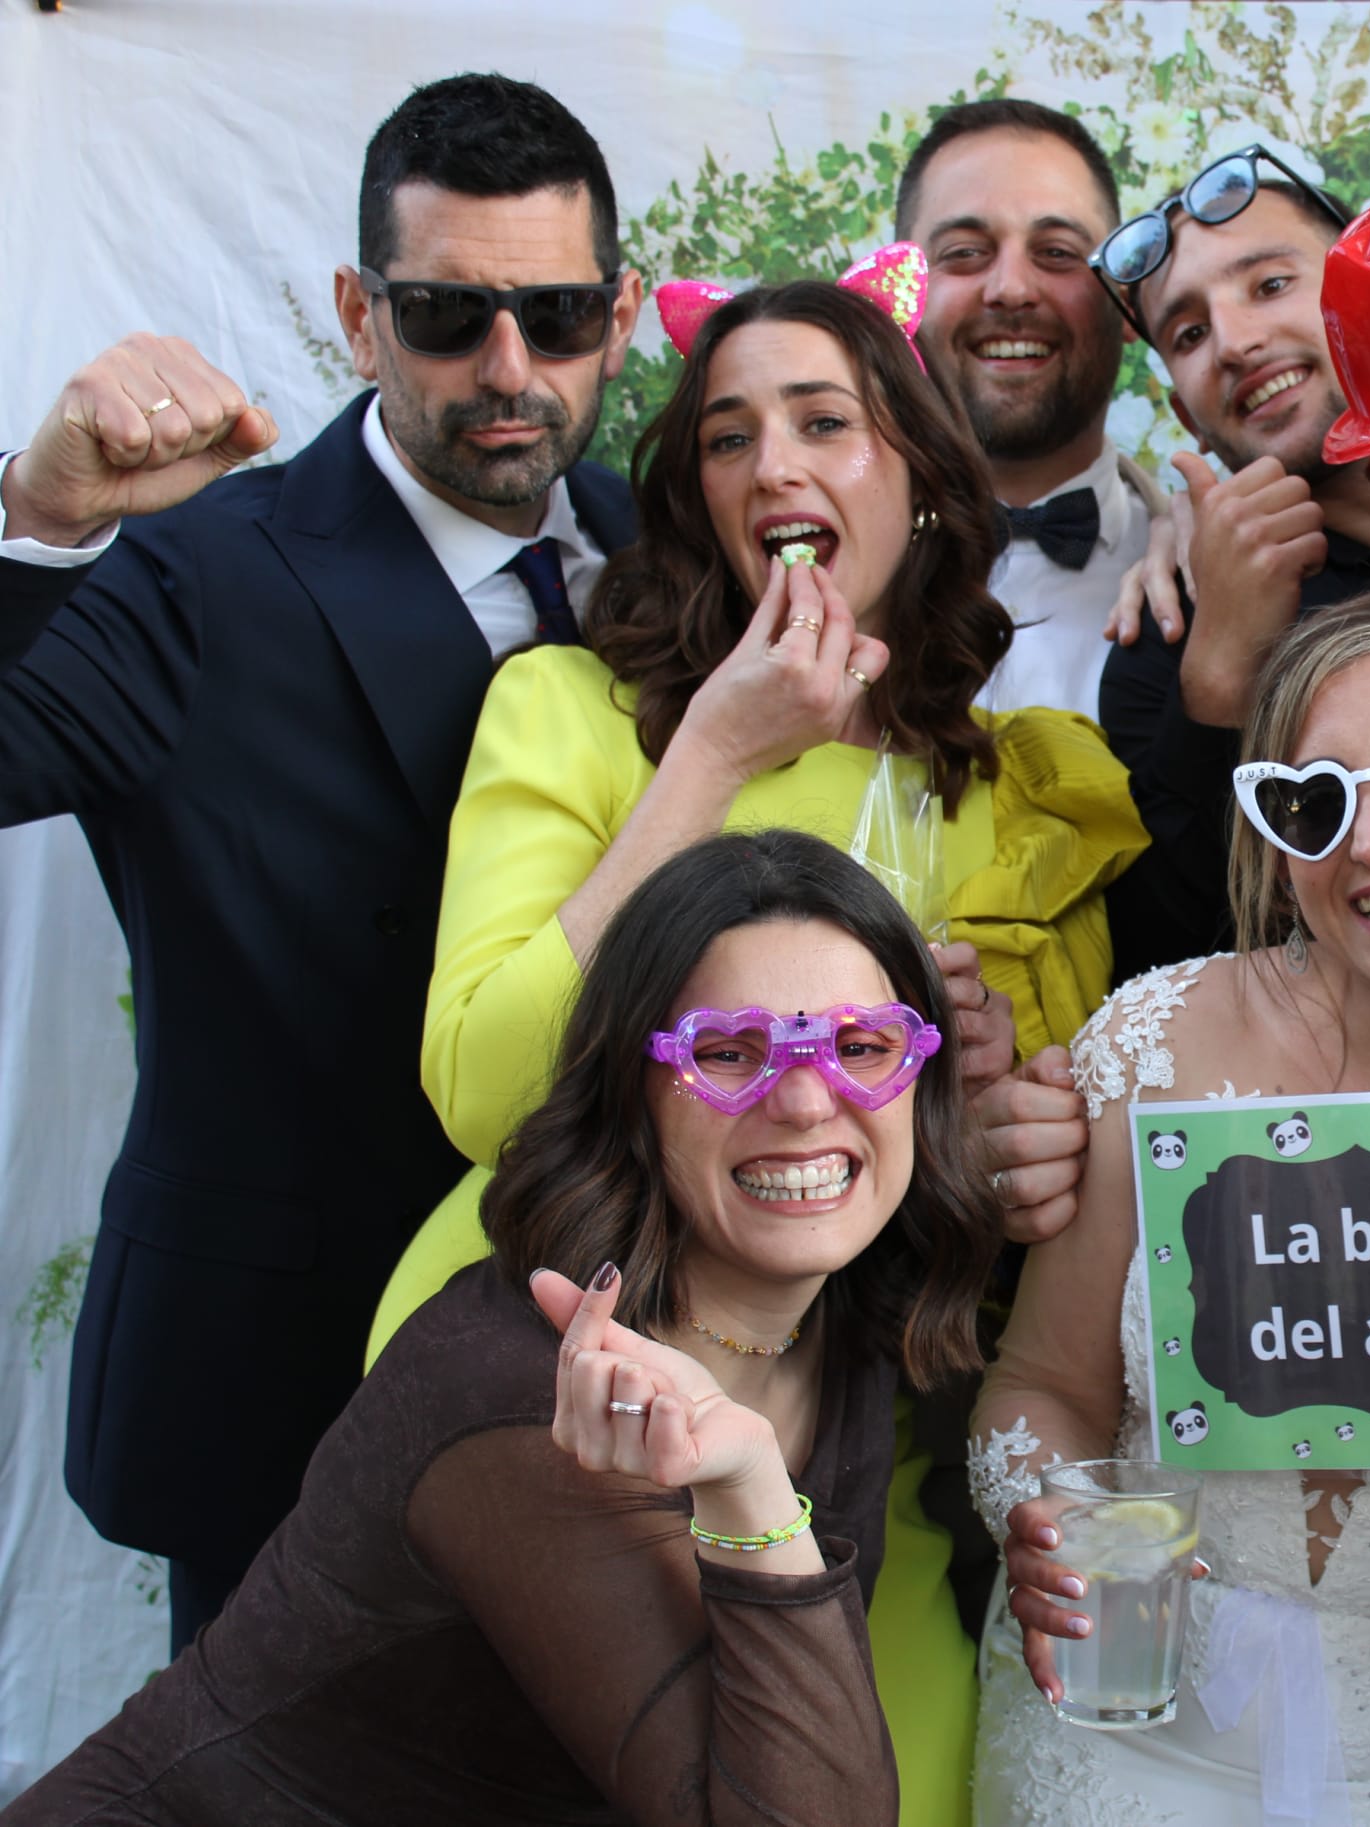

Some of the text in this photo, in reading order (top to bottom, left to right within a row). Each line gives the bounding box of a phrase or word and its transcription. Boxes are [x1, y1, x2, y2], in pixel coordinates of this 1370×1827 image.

[1236, 766, 1276, 780] JUST
[1250, 1213, 1321, 1265] La
[1250, 1304, 1343, 1361] del
